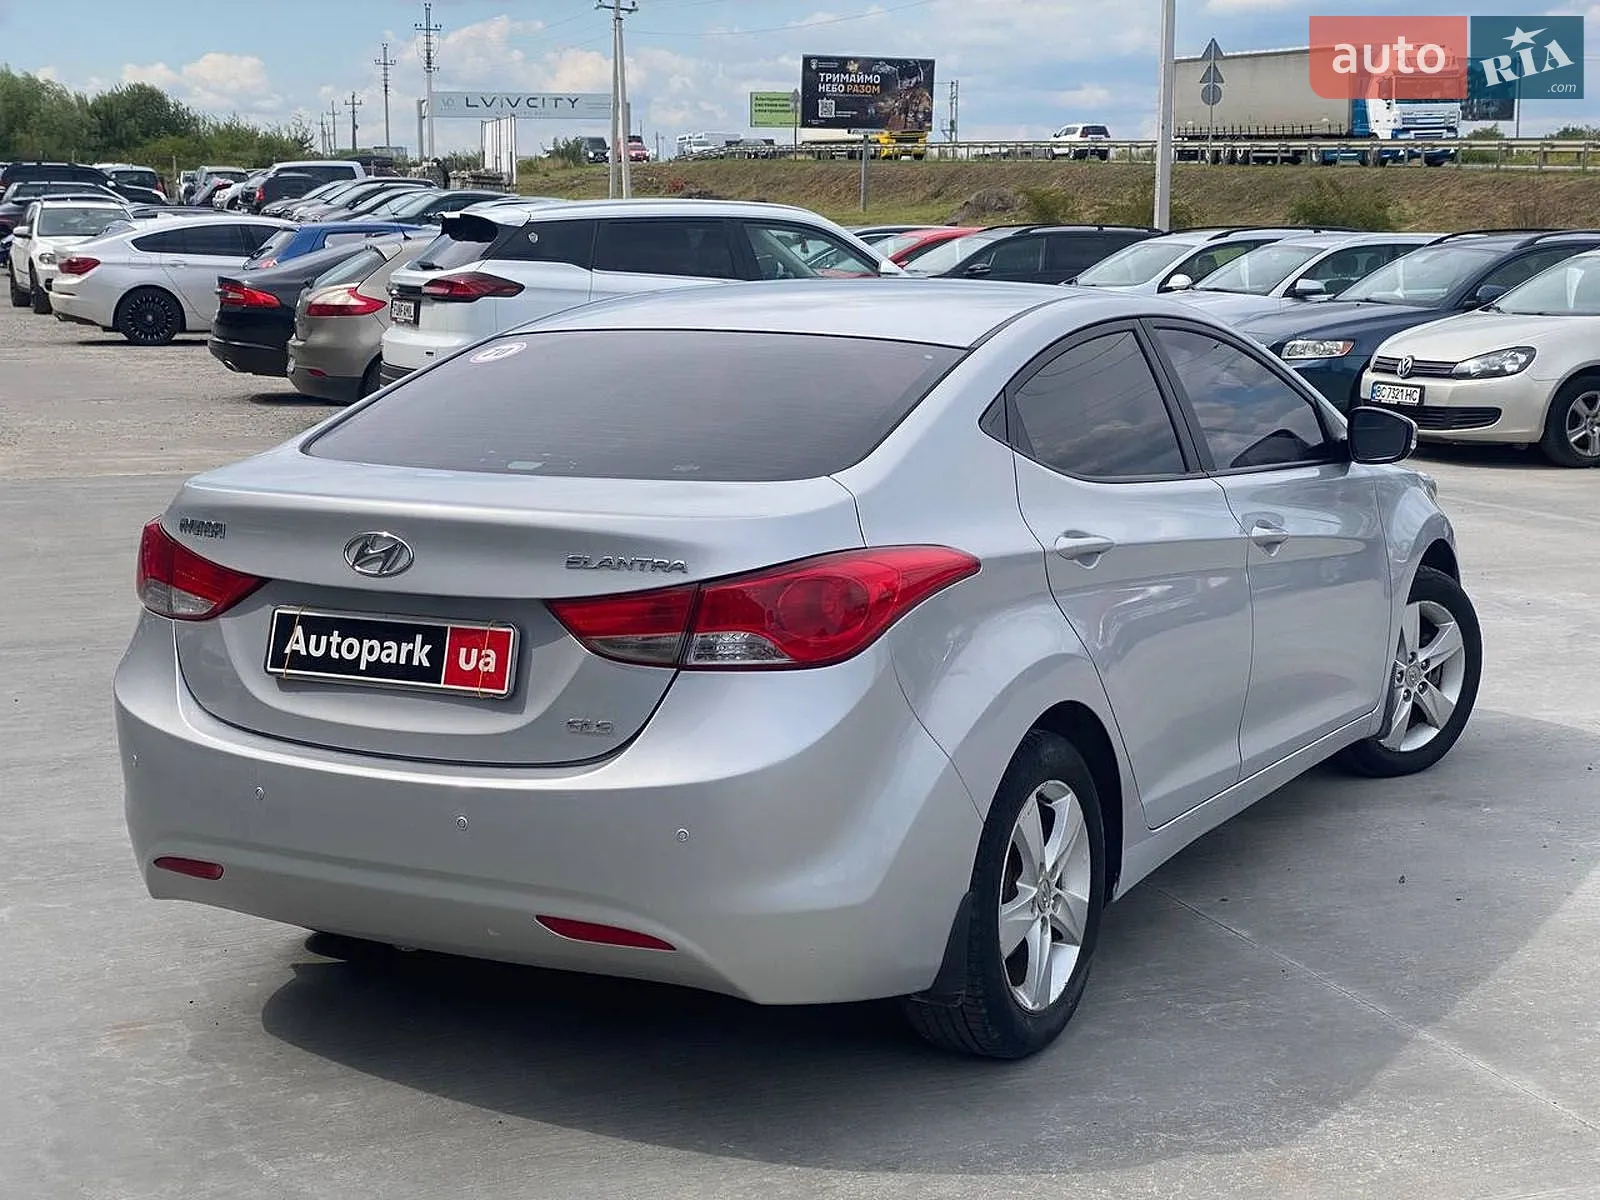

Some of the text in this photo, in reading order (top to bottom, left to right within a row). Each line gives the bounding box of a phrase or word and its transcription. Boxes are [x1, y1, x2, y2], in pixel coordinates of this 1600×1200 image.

[819, 72, 881, 84] ТРИМАЙМО
[818, 83, 881, 94] НЕБО РАЗОМ
[565, 554, 689, 574] ELANTRA
[284, 625, 497, 673] Autopark ua
